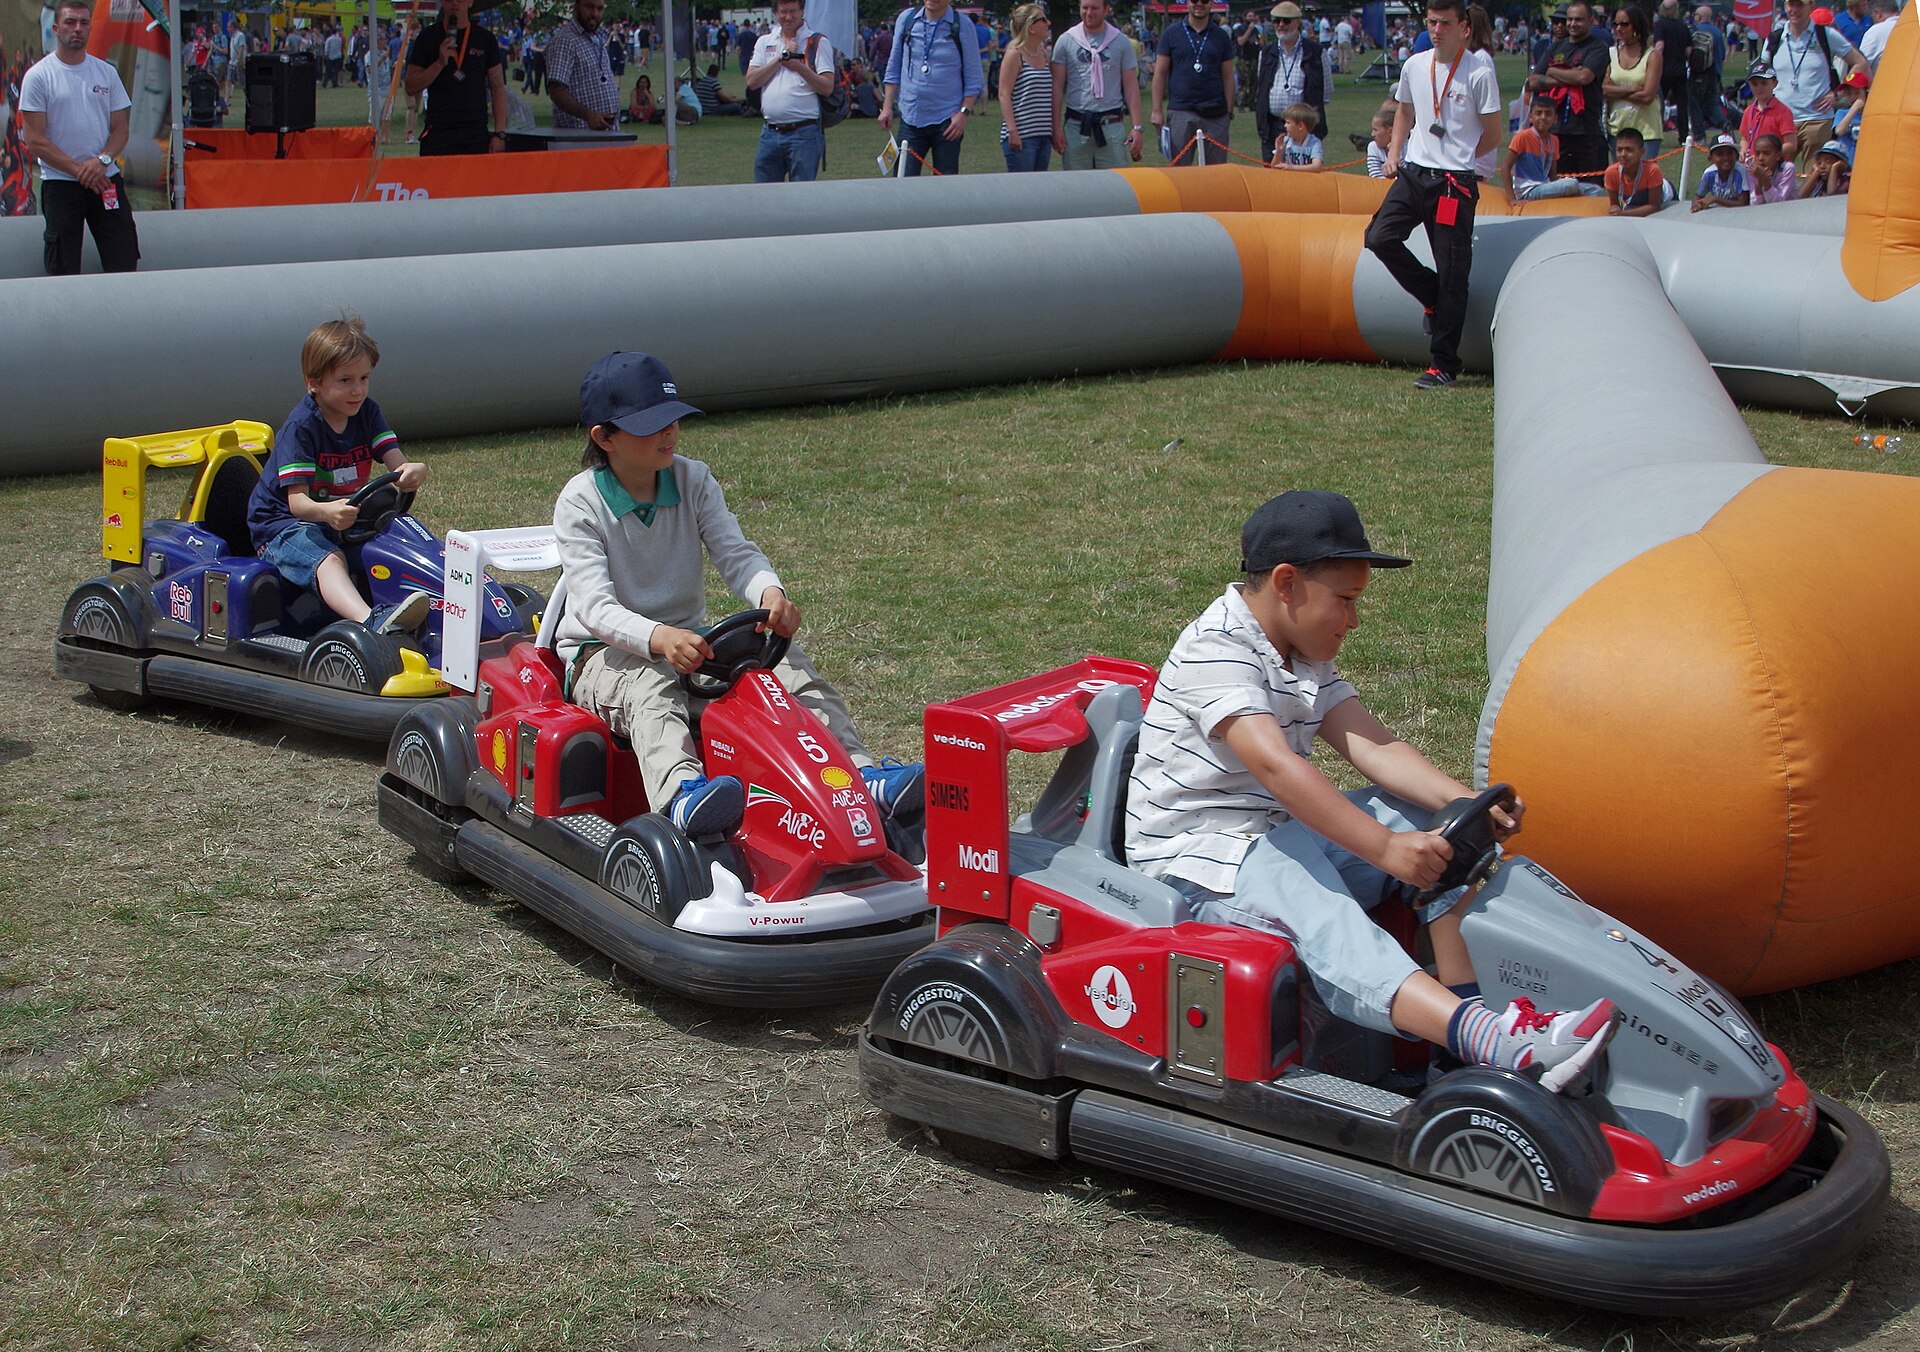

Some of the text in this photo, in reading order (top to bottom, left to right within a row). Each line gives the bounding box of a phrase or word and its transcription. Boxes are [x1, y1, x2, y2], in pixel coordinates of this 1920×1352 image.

[375, 182, 429, 202] The
[330, 644, 367, 684] BRIGGESTON
[757, 673, 791, 711] acher
[797, 735, 829, 763] 5
[933, 733, 986, 751] vedafon
[930, 781, 970, 812] SIMENS
[627, 843, 661, 904] BRIGGESTON
[958, 844, 999, 874] Modil
[749, 916, 805, 926] V-Powur
[1499, 958, 1549, 981] JIONNI
[900, 988, 964, 1032] BRIGGESTON
[1083, 985, 1137, 1013] vedafon
[1470, 1113, 1556, 1194] BRIGGESTON
[1682, 1178, 1738, 1205] vedafon
